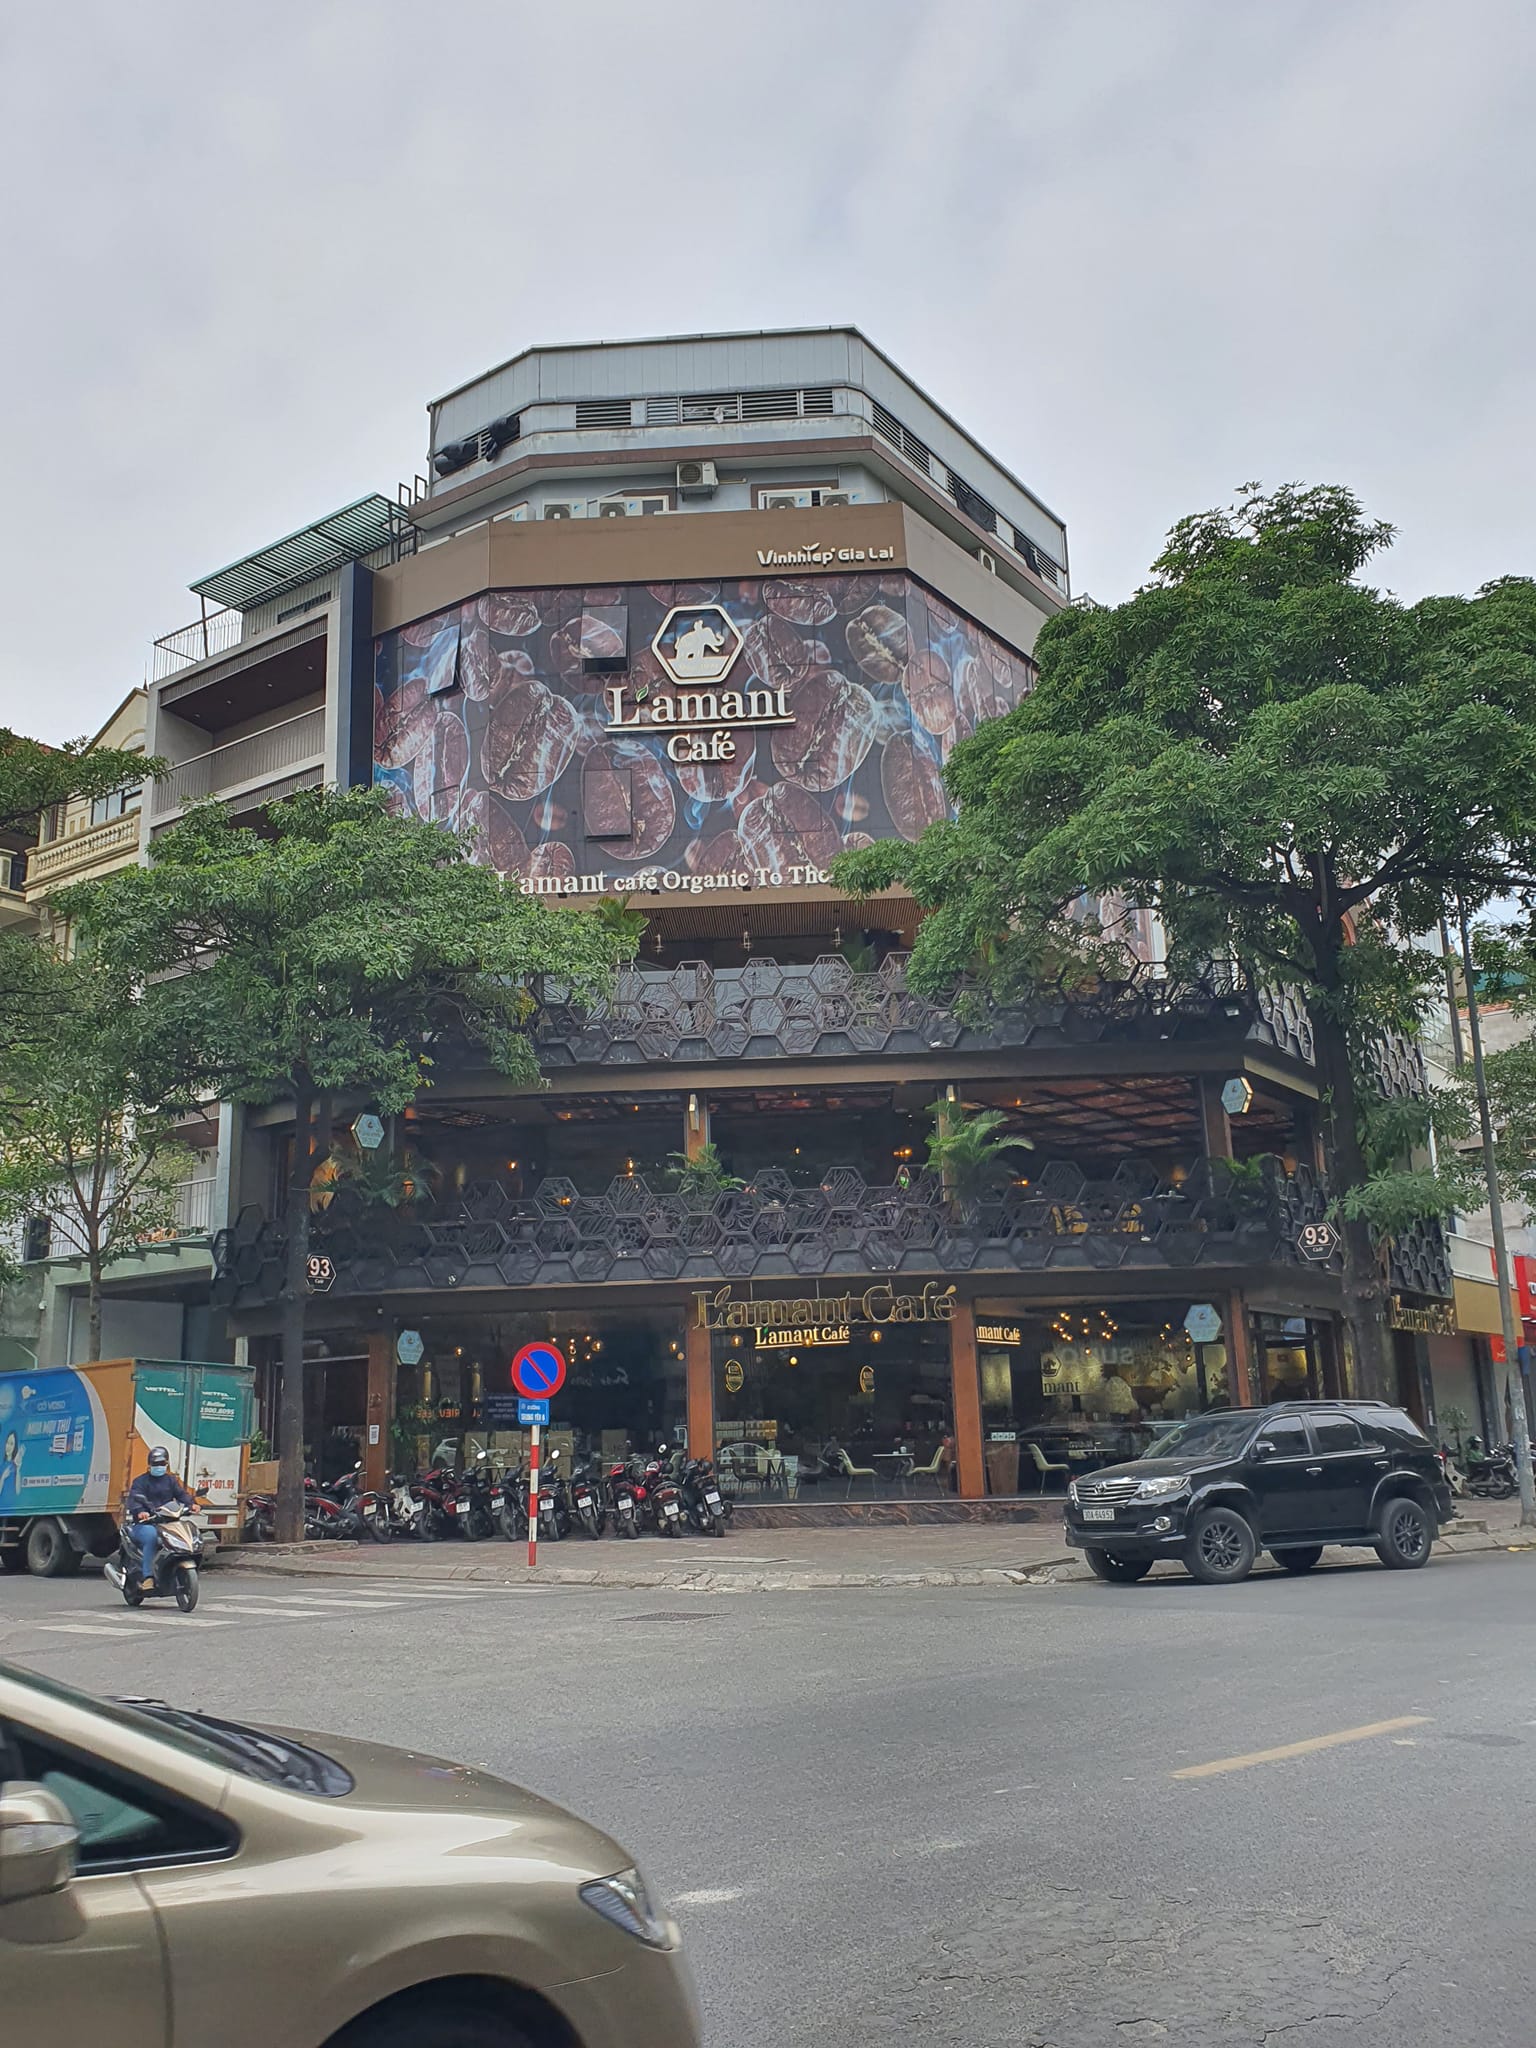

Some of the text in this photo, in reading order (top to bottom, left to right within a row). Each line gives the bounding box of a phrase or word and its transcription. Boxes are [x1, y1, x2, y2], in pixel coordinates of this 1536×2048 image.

[838, 548, 865, 561] Gia
[868, 546, 894, 560] Lai
[606, 684, 796, 727] L'amant
[667, 731, 737, 763] Café
[614, 868, 659, 891] café
[662, 869, 750, 894] Organic
[753, 867, 784, 887] To
[788, 864, 830, 885] The
[1305, 1225, 1330, 1246] 93
[310, 1257, 331, 1277] 93
[690, 1280, 959, 1330] L'amant Café
[754, 1325, 850, 1346] L'amant Café
[1004, 1327, 1021, 1341] Café
